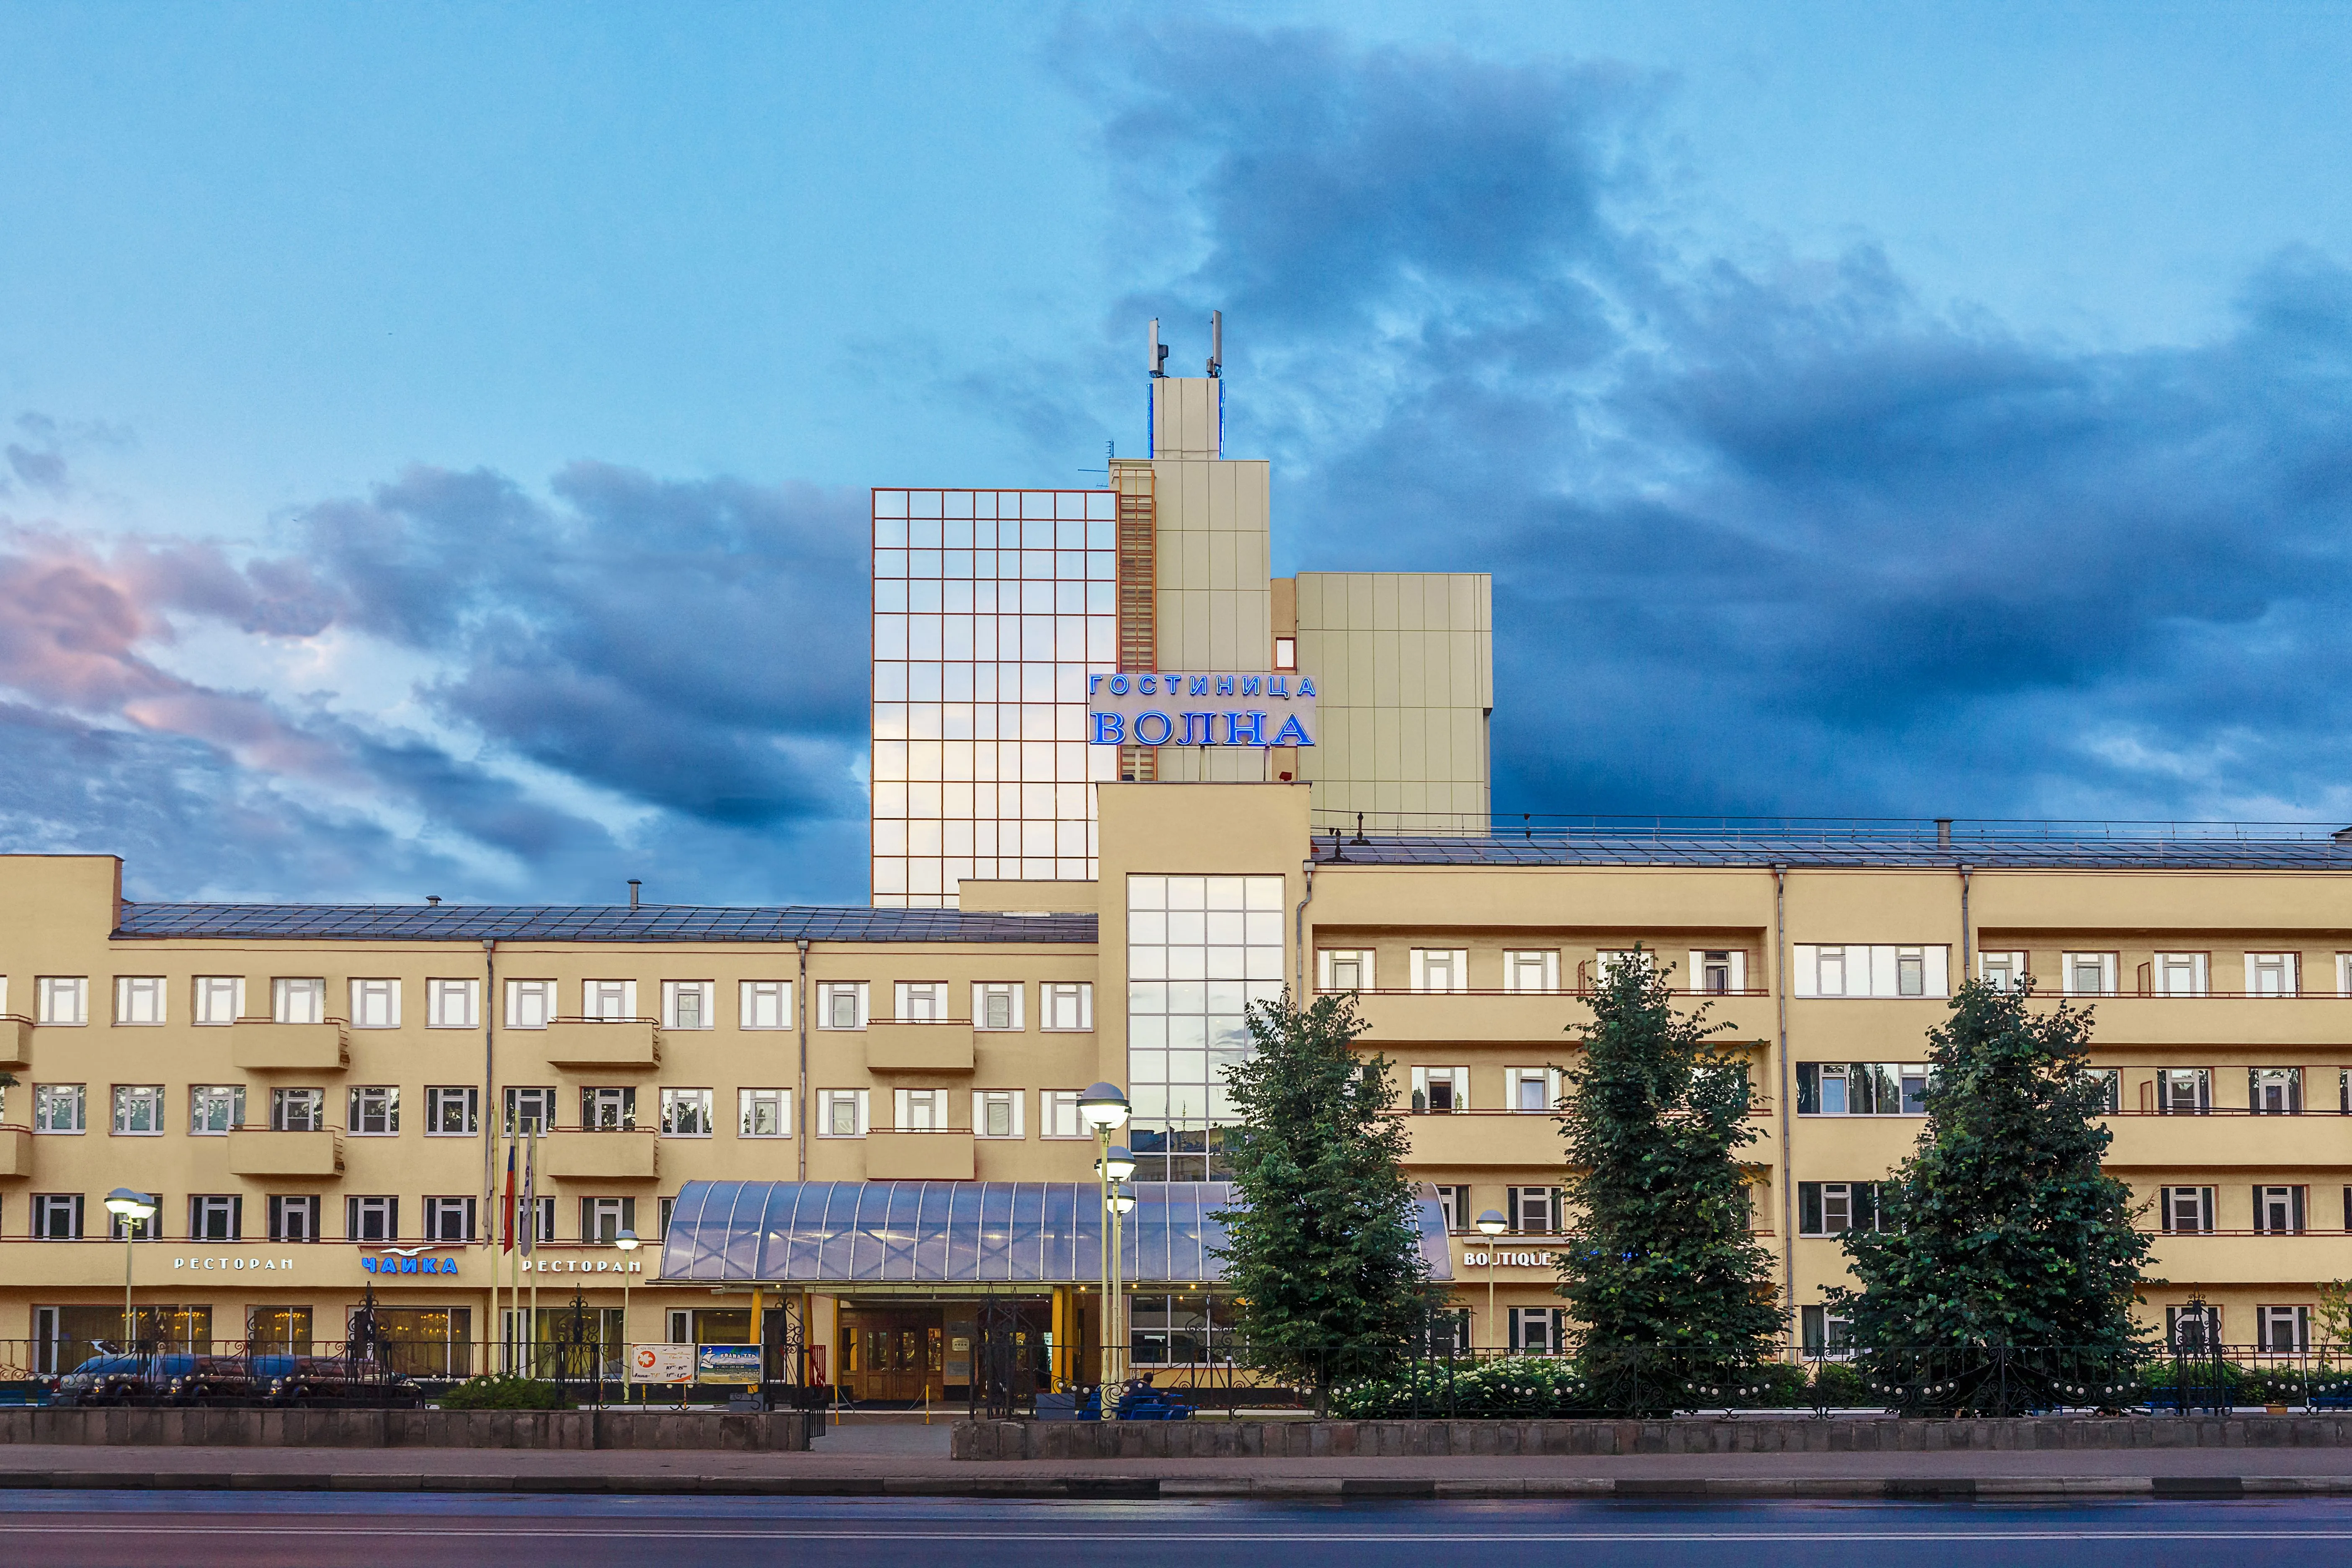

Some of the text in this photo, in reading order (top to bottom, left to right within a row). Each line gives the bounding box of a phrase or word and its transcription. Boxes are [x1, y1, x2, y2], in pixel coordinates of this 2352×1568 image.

[1089, 674, 1315, 699] ГОСТИНИЦА
[1090, 711, 1315, 745] ВОЛНА
[174, 1258, 293, 1270] РЕСТОРАН
[522, 1260, 641, 1272] РЕСТОРАН
[1464, 1252, 1552, 1266] BOUTIQUE
